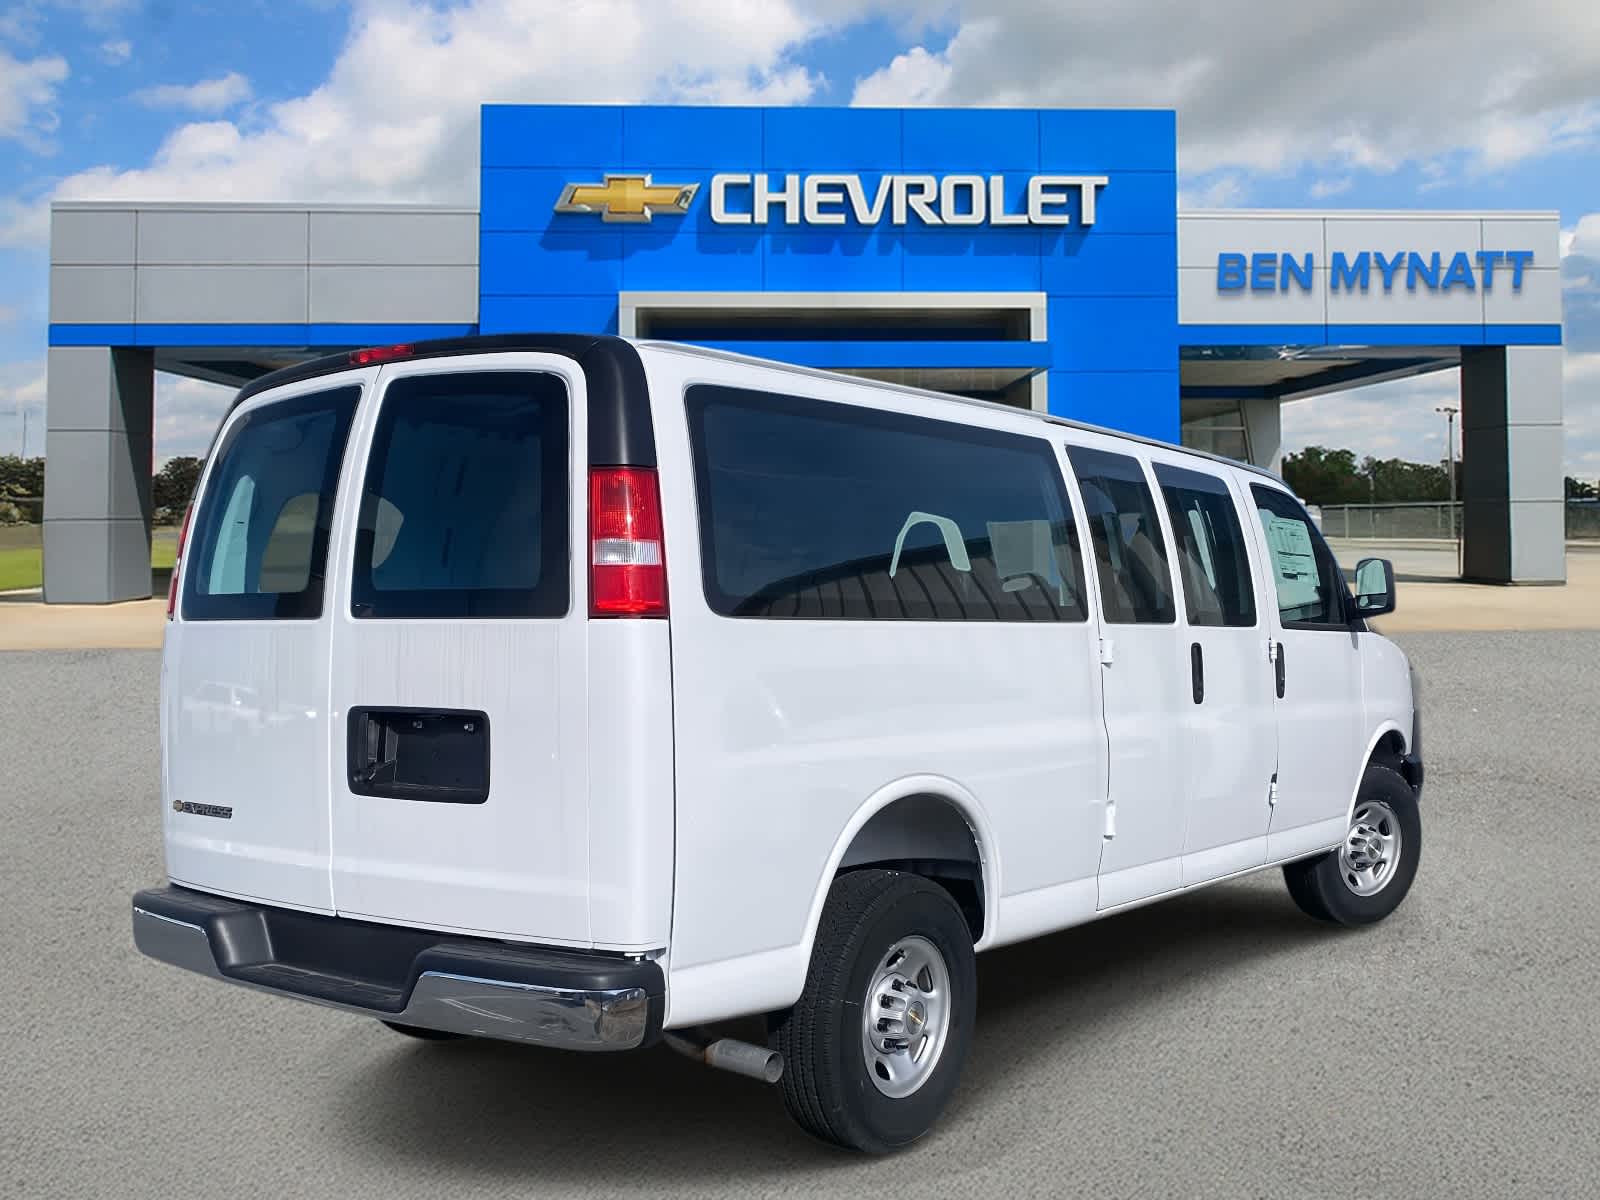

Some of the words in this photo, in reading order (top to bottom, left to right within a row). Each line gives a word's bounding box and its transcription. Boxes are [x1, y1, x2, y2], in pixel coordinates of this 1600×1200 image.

[710, 173, 1109, 225] CHEVROLET
[1217, 253, 1313, 290] BEN
[1330, 251, 1534, 290] MYNATT
[183, 801, 233, 819] EXPRESS
